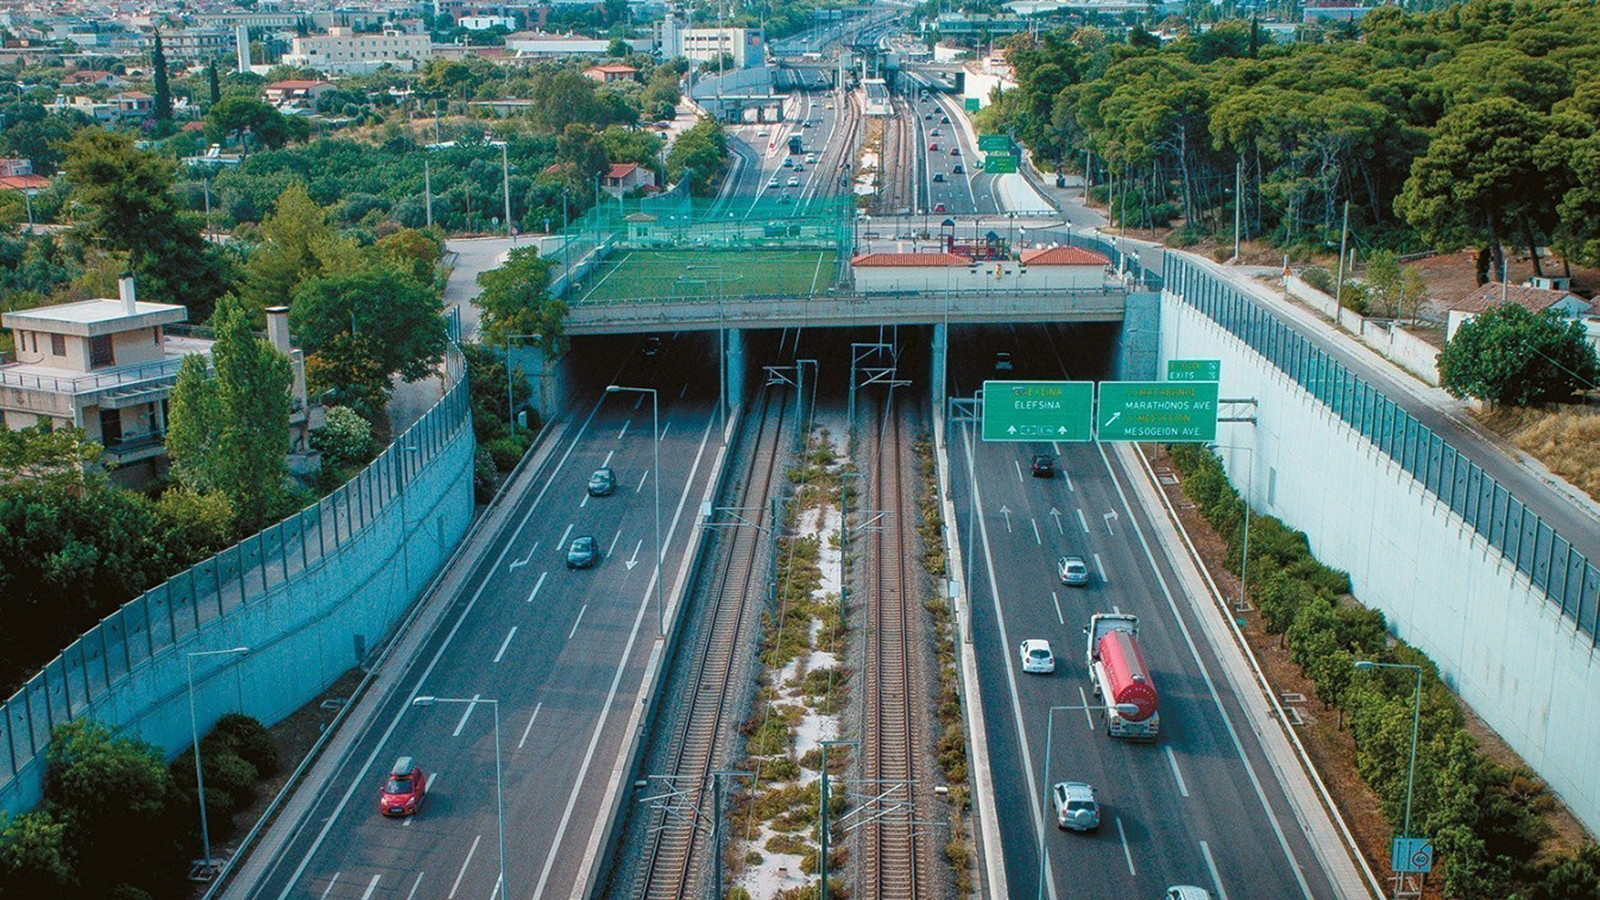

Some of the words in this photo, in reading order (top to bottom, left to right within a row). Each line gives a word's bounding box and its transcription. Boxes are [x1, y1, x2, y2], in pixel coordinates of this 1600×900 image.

[1170, 371, 1194, 379] EXITS
[1014, 400, 1061, 409] ELEFSINA
[1125, 401, 1189, 410] MARATHONOS
[1193, 401, 1211, 409] AVE
[1124, 427, 1178, 436] MESOGEION
